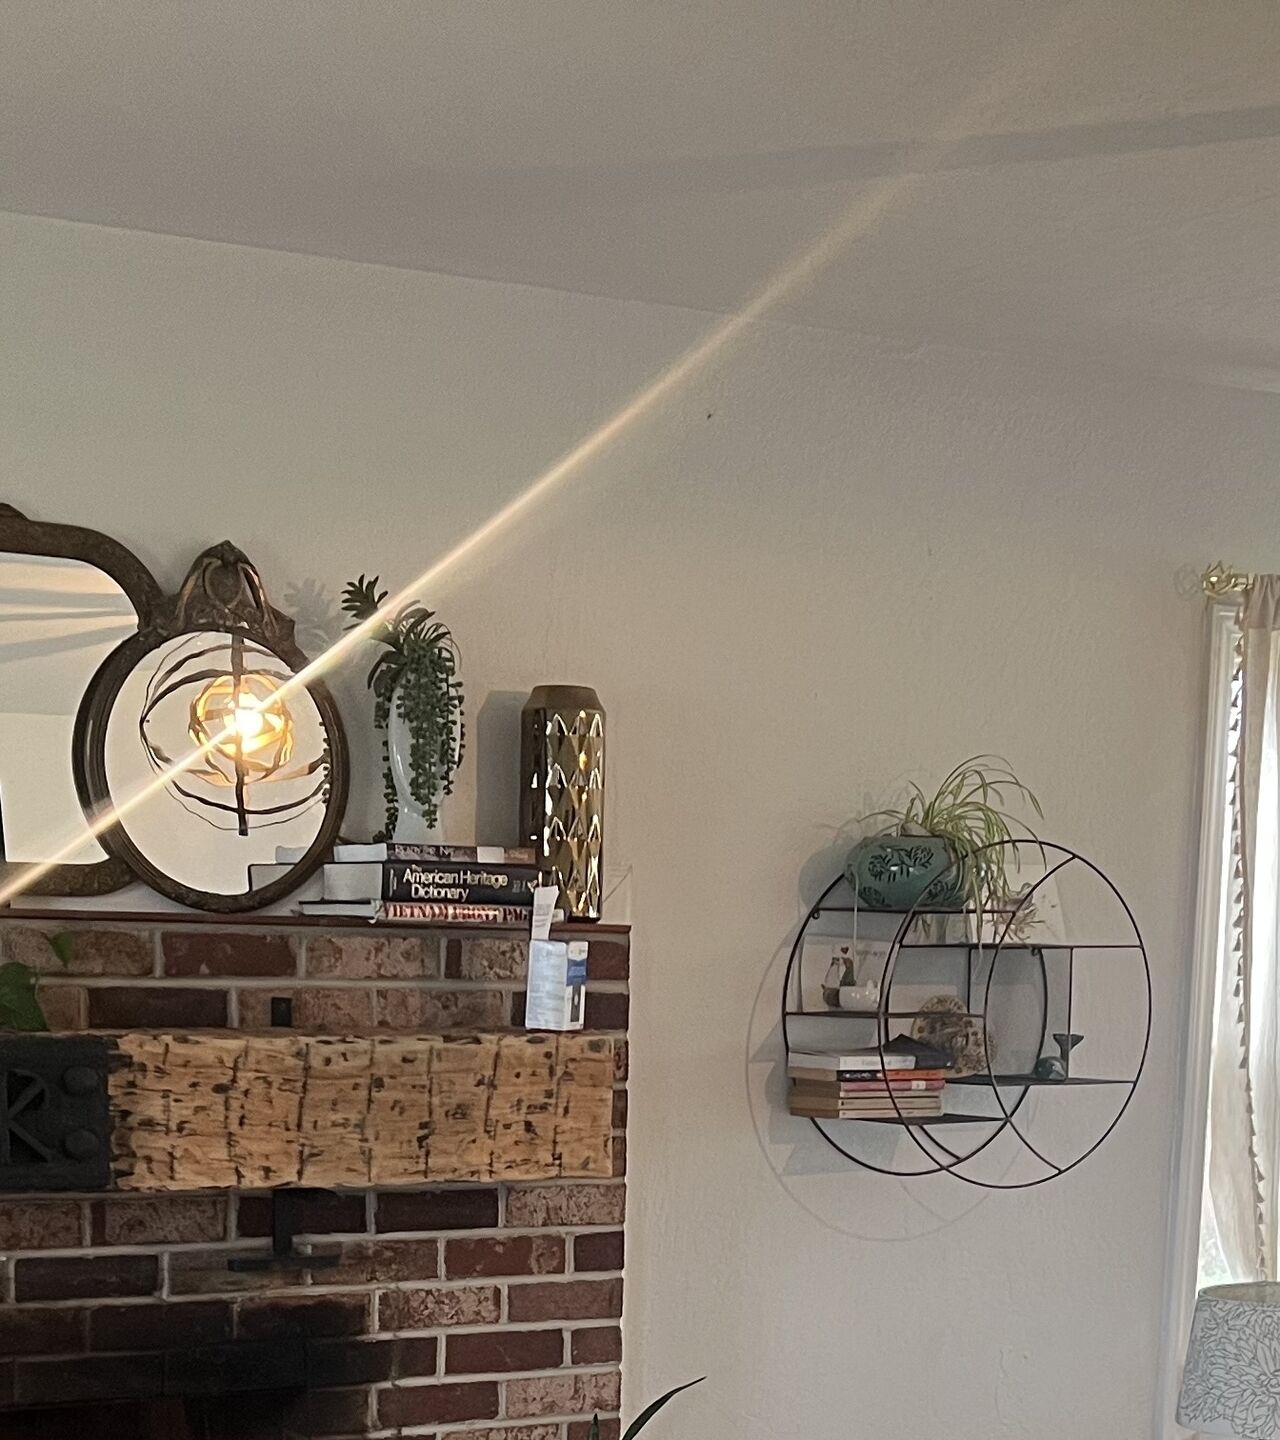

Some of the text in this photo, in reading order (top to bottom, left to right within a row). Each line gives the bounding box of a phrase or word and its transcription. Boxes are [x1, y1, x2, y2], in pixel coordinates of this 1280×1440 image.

[403, 868, 459, 884] American
[460, 870, 508, 889] Heritage
[411, 883, 469, 902] Dictionary
